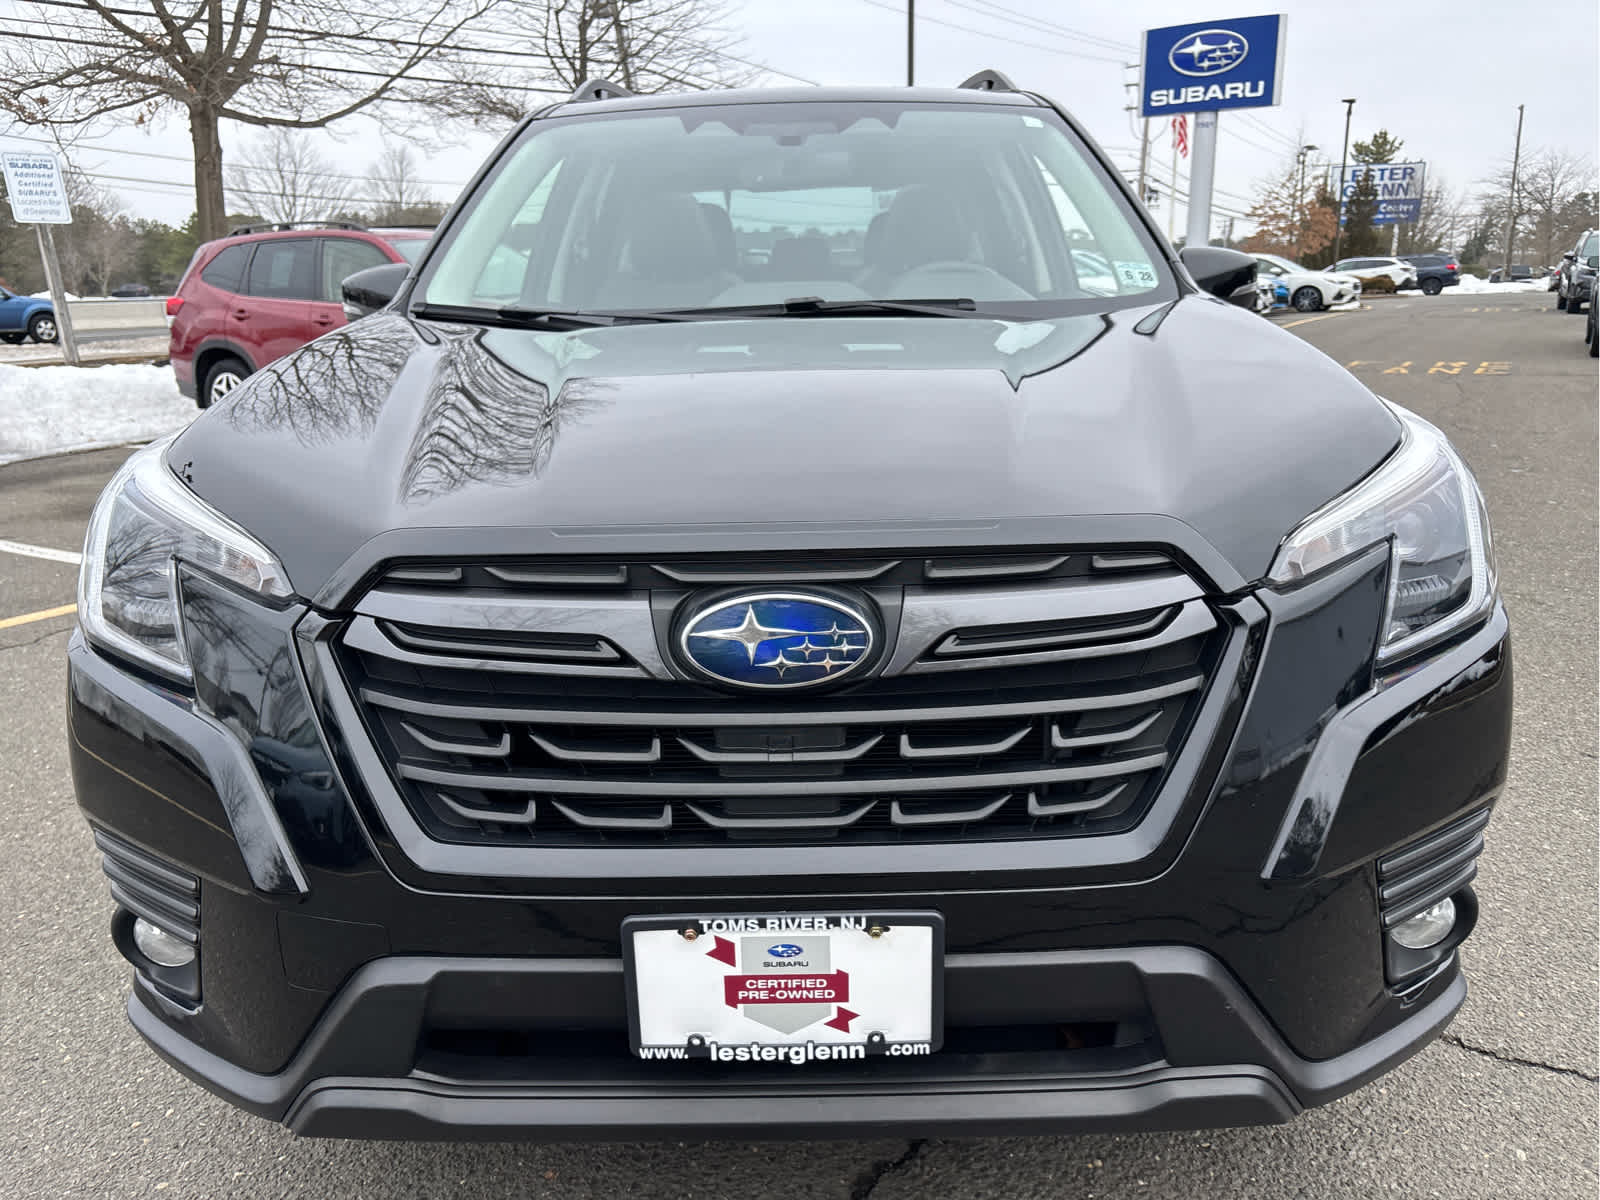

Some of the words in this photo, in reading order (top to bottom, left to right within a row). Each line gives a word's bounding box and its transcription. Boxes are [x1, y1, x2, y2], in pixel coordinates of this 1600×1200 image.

[1150, 80, 1265, 107] SUBARU
[8, 162, 54, 170] SUBARU
[18, 180, 54, 188] Certified
[1343, 183, 1410, 198] GNN
[1125, 270, 1134, 280] 6
[1138, 271, 1154, 281] 28
[699, 919, 760, 934] TOMS
[840, 917, 867, 931] NJ
[762, 960, 809, 968] SUBARU
[745, 979, 828, 989] CERTIFIED
[738, 990, 836, 1000] PRE-OWNED
[710, 1043, 866, 1065] lesterglenn
